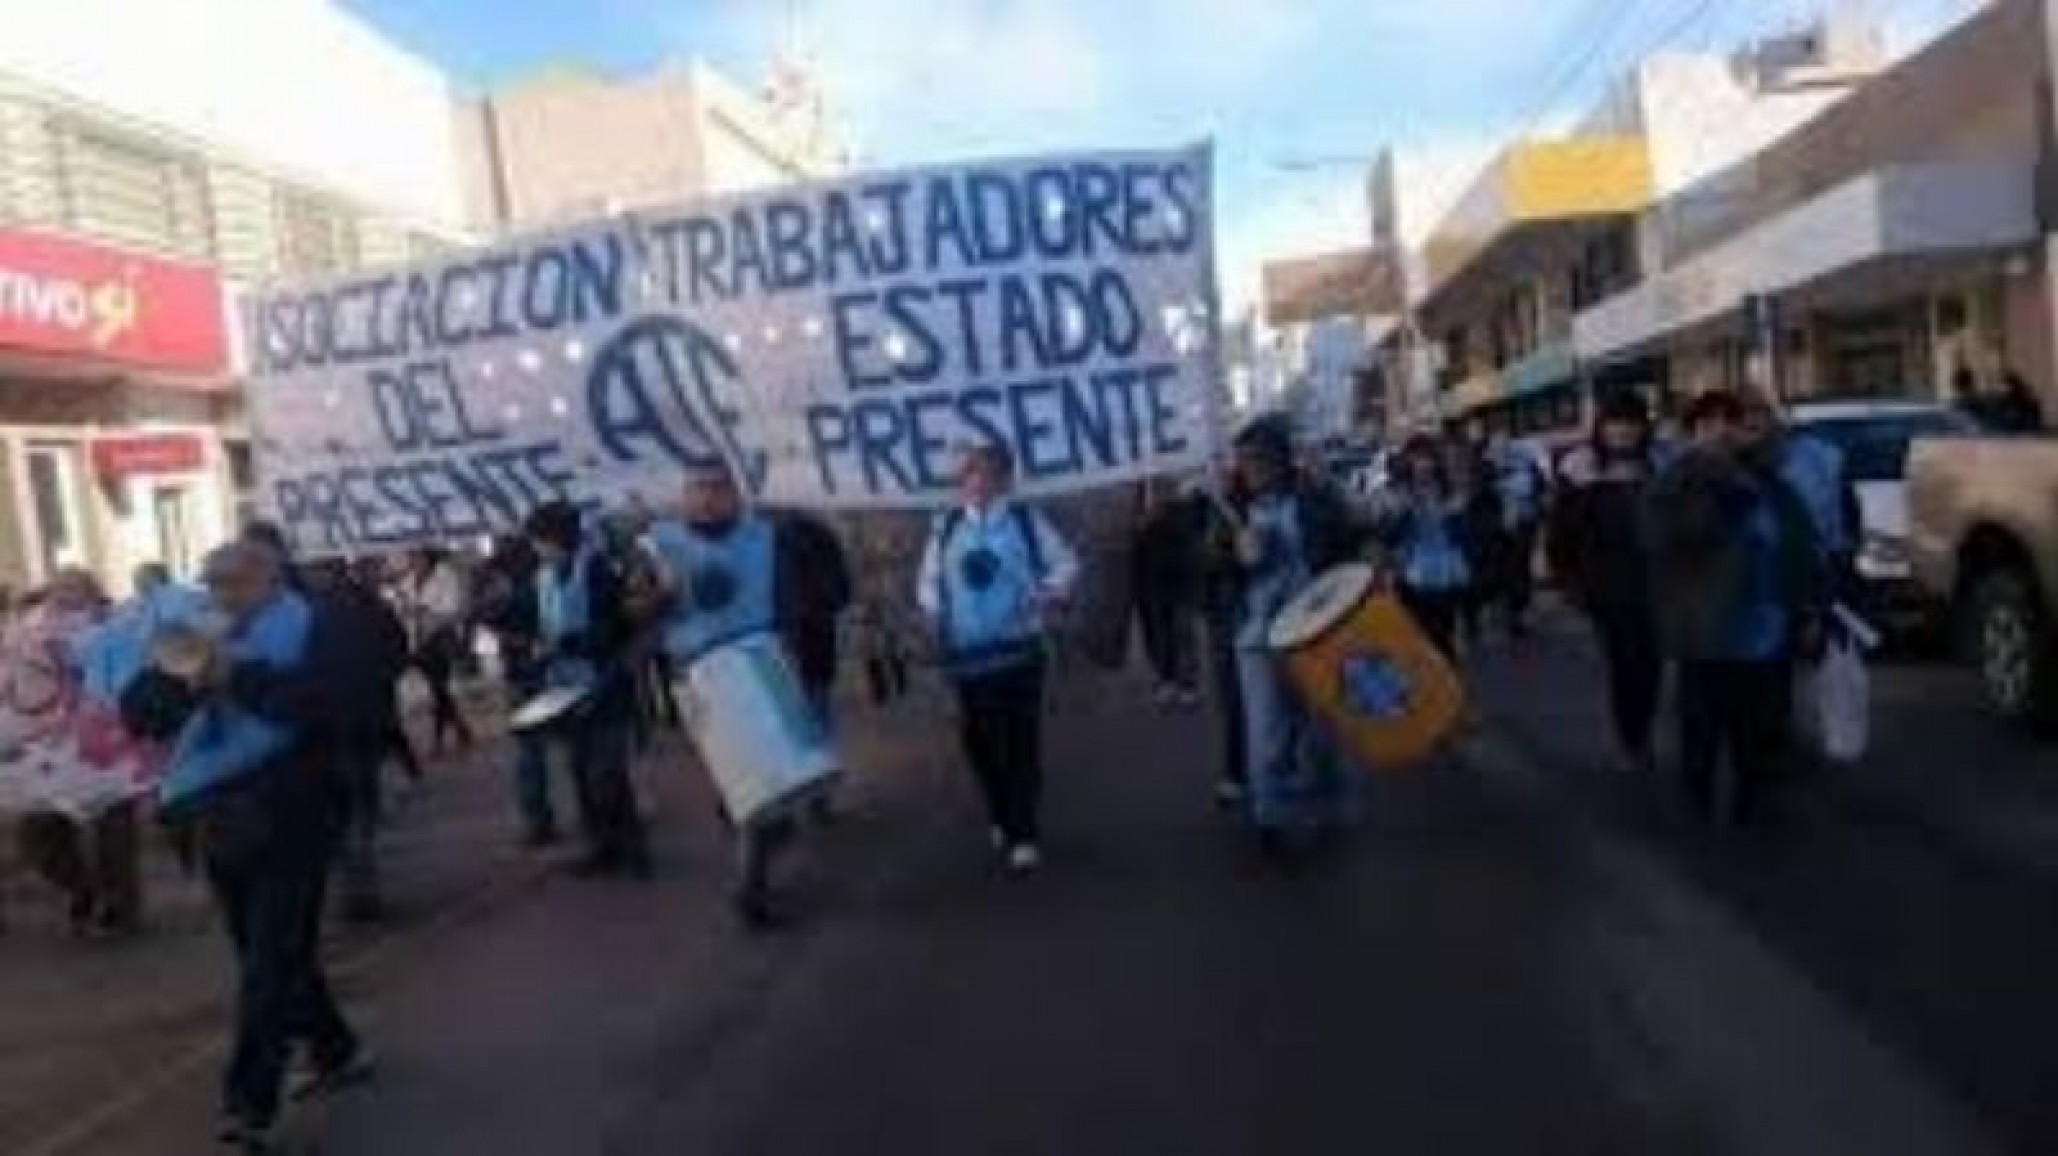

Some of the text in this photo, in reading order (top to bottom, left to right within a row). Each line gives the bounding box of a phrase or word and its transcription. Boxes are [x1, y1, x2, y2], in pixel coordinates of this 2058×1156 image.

[648, 163, 1196, 303] TRABAJADORES
[368, 267, 1142, 451] DEL ESTADO
